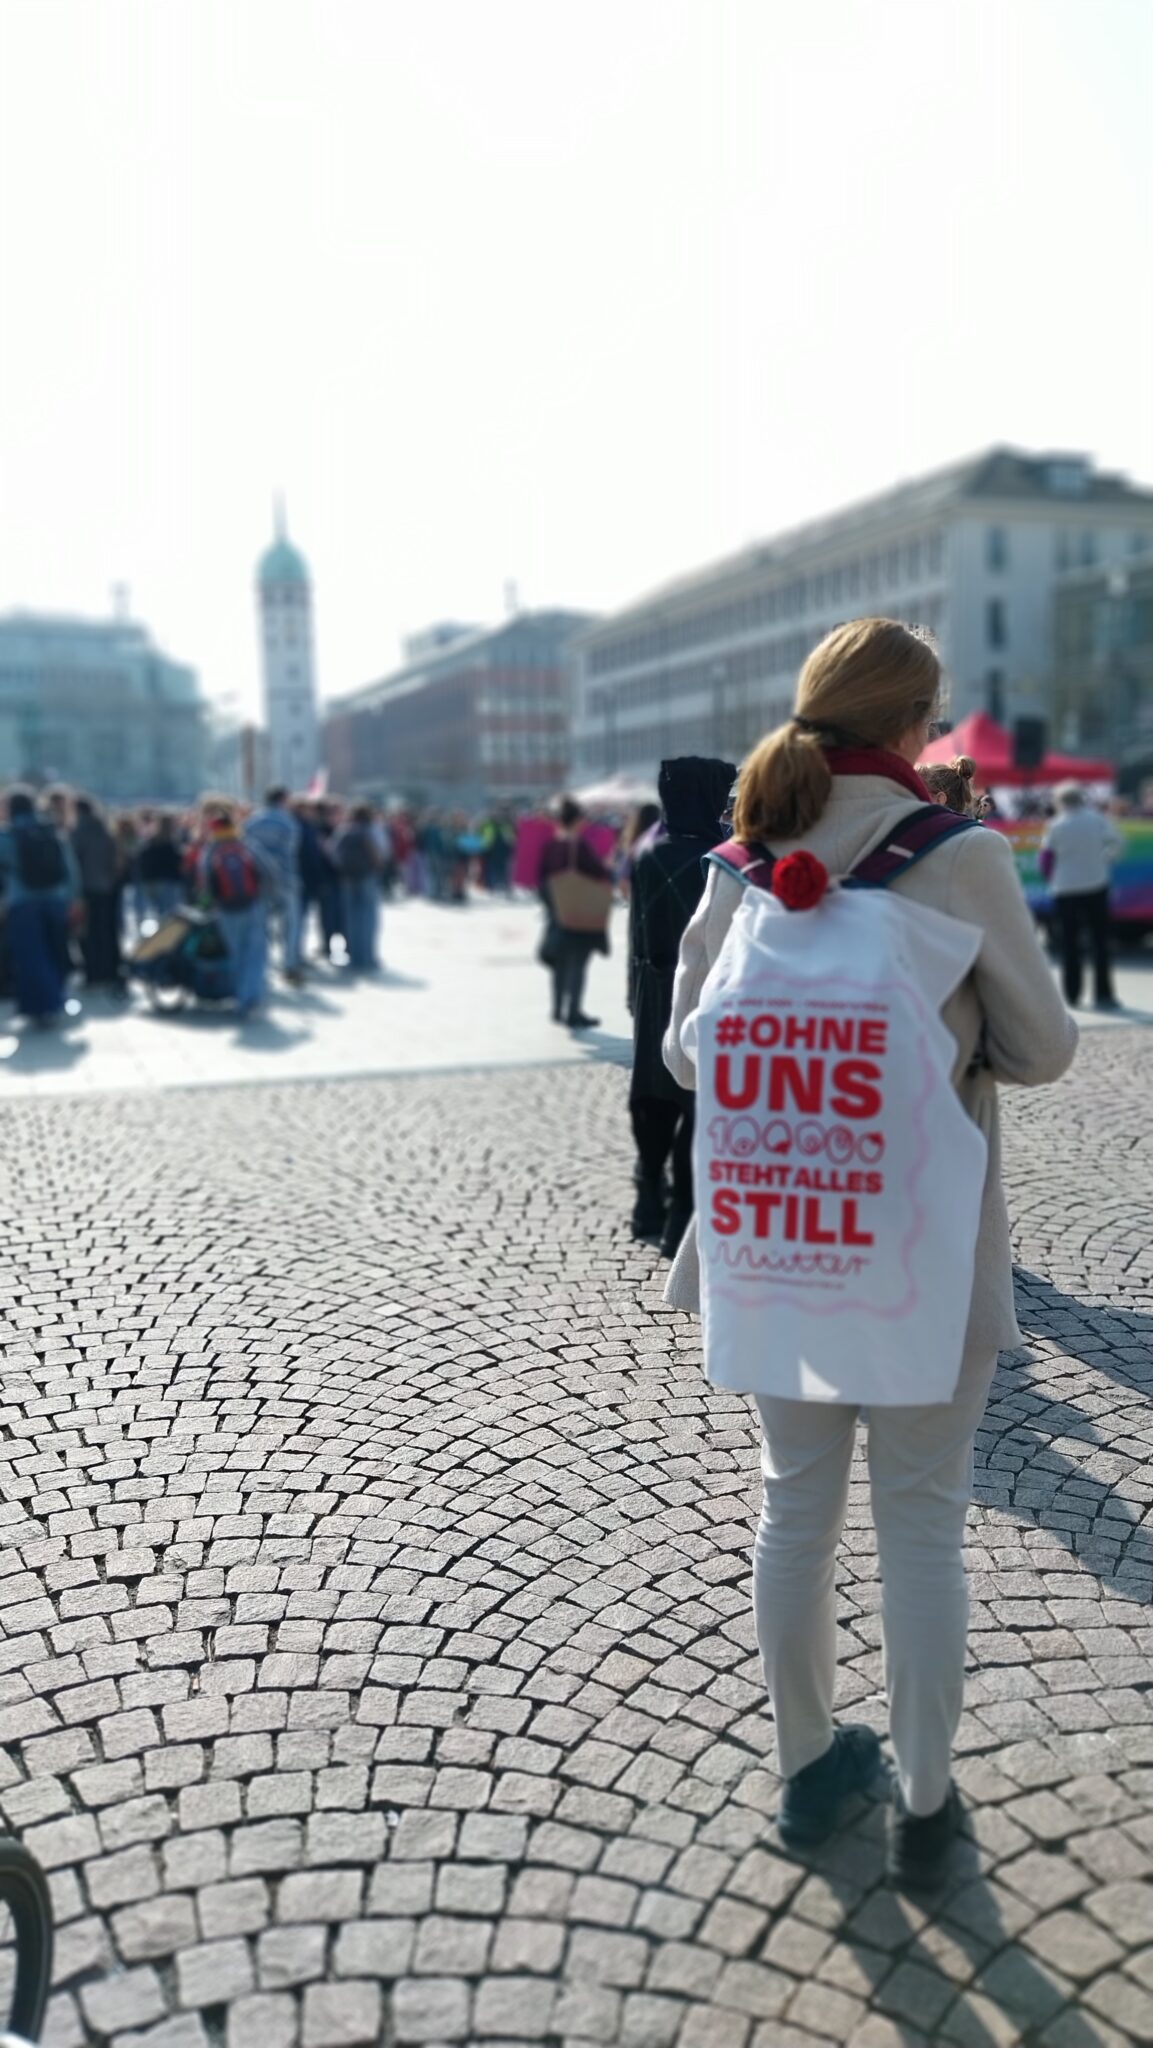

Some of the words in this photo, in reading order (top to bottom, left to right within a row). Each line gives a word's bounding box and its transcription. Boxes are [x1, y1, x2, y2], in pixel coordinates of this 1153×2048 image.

[714, 1014, 888, 1055] #OHNE
[713, 1054, 884, 1120] UNS
[709, 1160, 791, 1187] STEHT
[795, 1167, 883, 1194] ALLES
[710, 1188, 875, 1247] STILL
